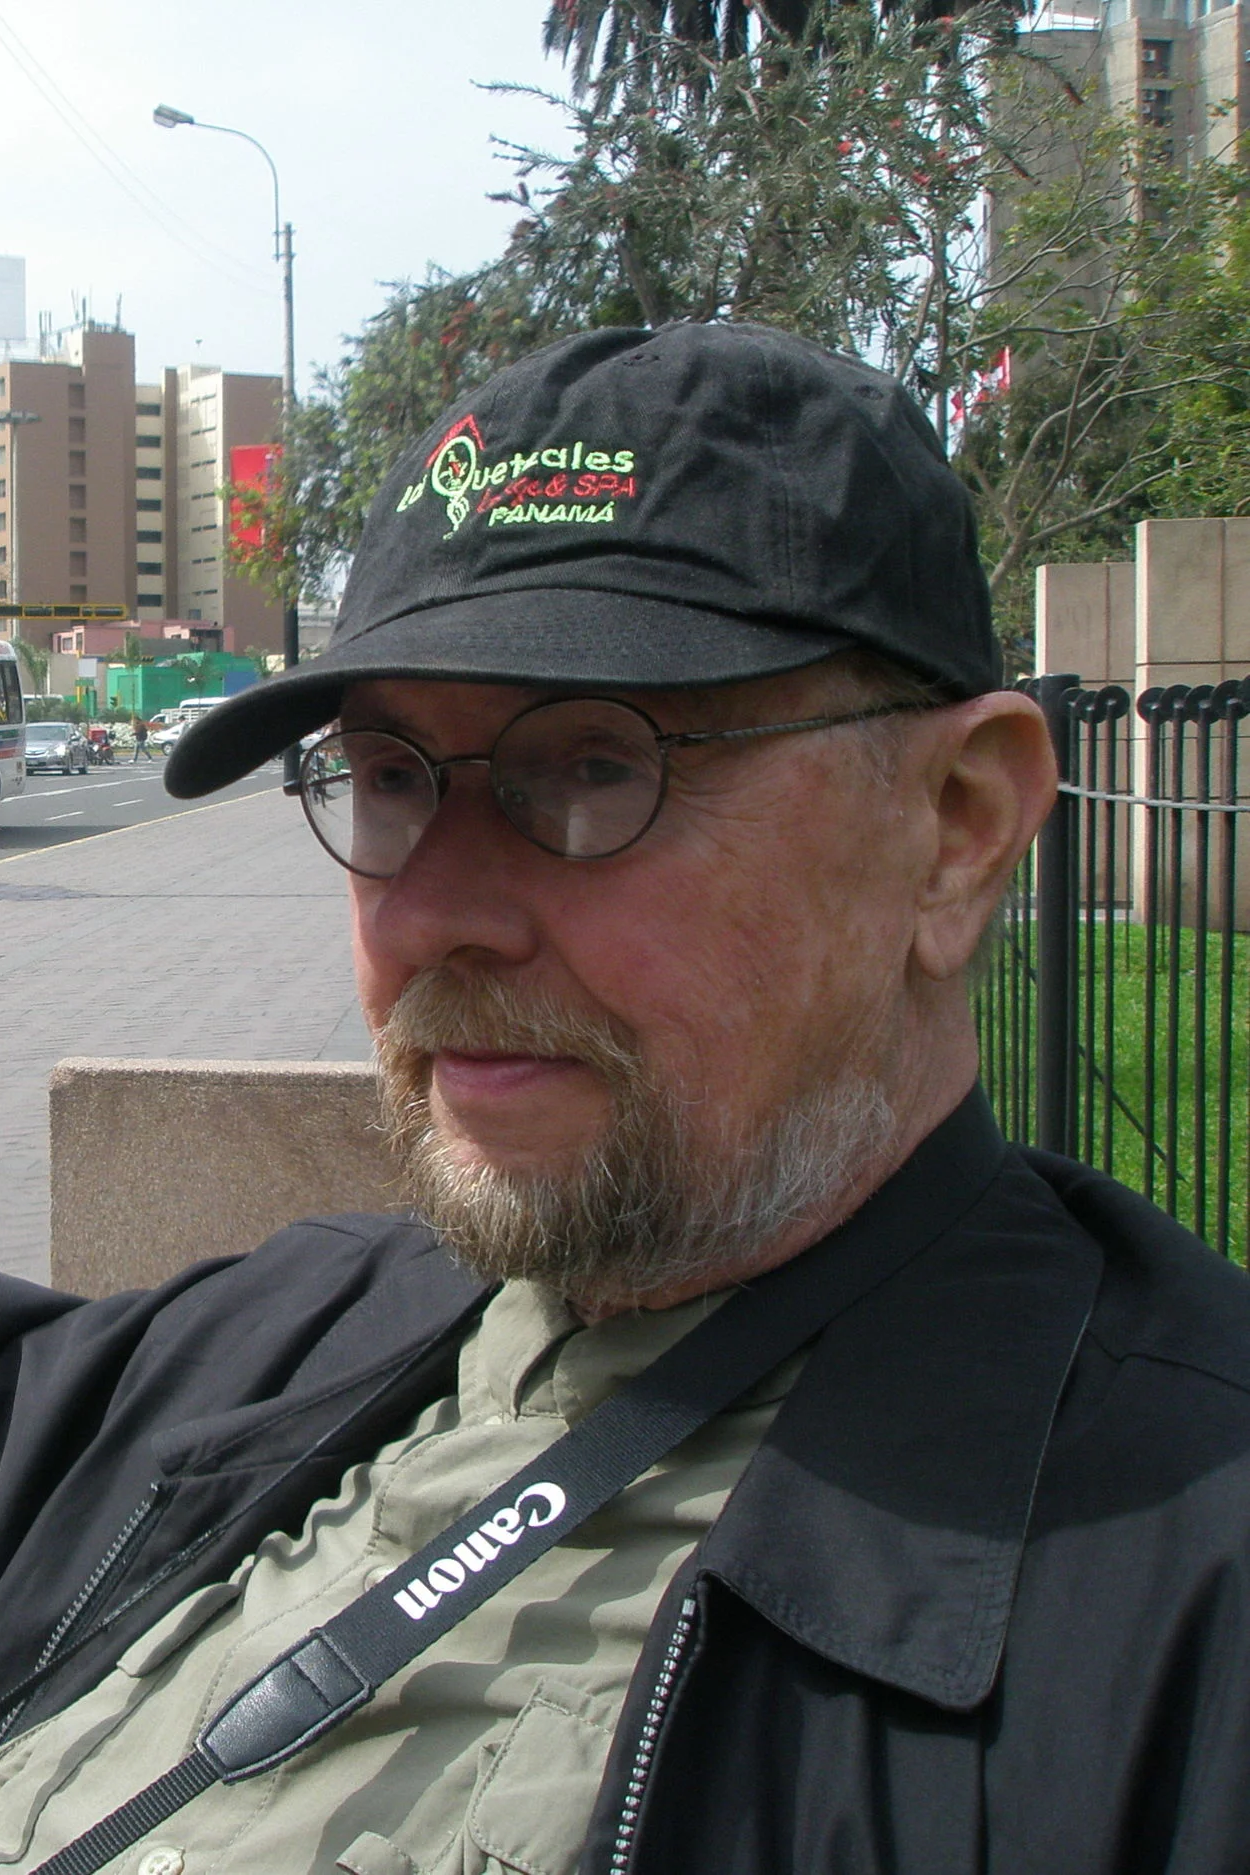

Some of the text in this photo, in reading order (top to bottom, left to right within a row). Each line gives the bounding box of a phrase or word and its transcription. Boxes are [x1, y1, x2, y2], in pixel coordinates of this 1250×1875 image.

[432, 437, 636, 498] Quetzales
[545, 473, 569, 498] &
[573, 473, 637, 498] SPA
[488, 501, 615, 528] PANAMÁ
[392, 1480, 567, 1621] Canon
